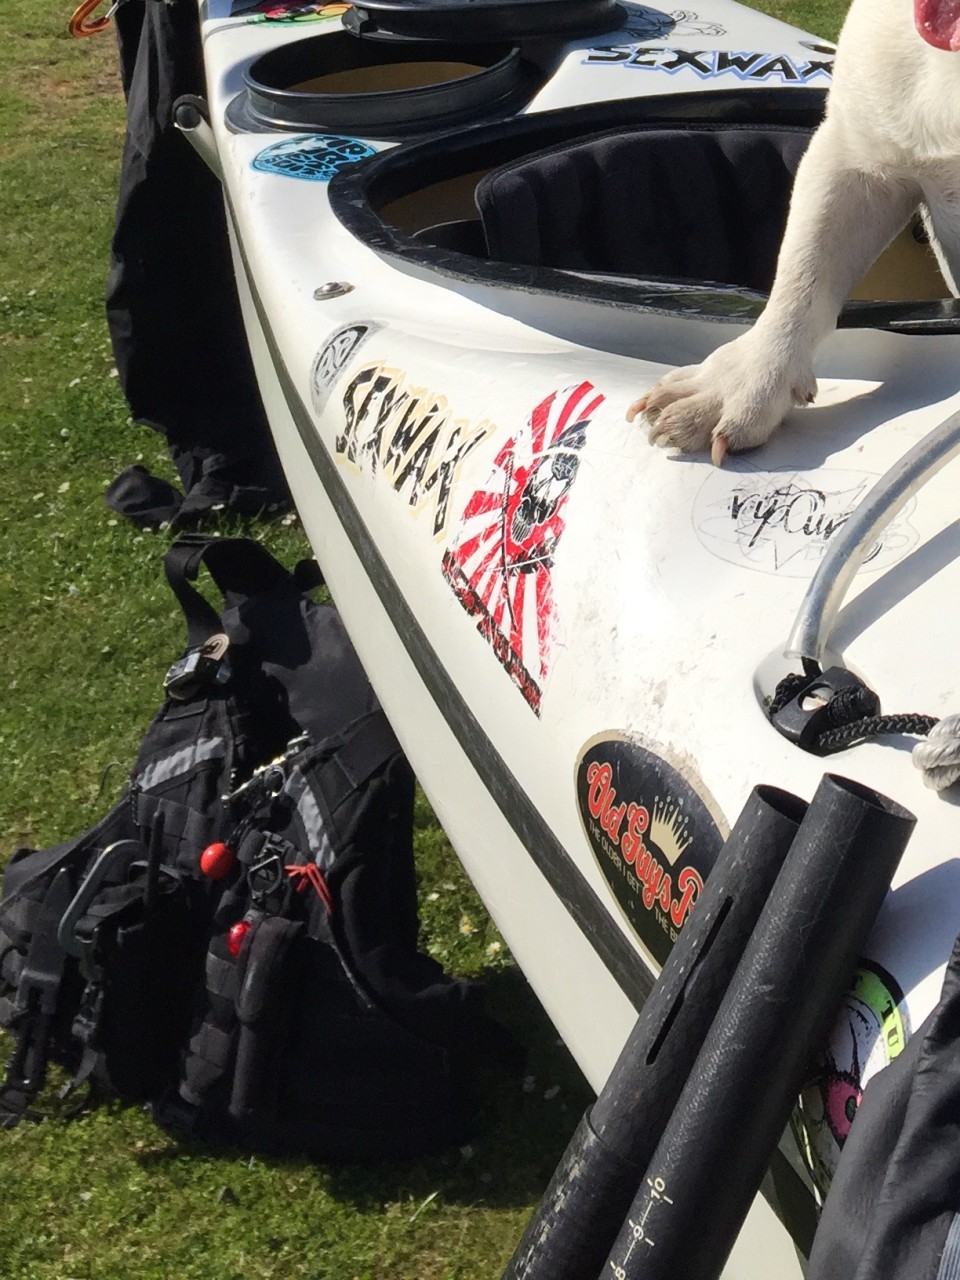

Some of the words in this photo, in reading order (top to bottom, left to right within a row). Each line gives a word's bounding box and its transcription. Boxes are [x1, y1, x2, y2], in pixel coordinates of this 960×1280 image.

[587, 761, 627, 845] Old
[621, 802, 671, 912] Guys
[589, 818, 601, 842] THE
[650, 1177, 666, 1199] 10
[633, 1225, 644, 1240] 9
